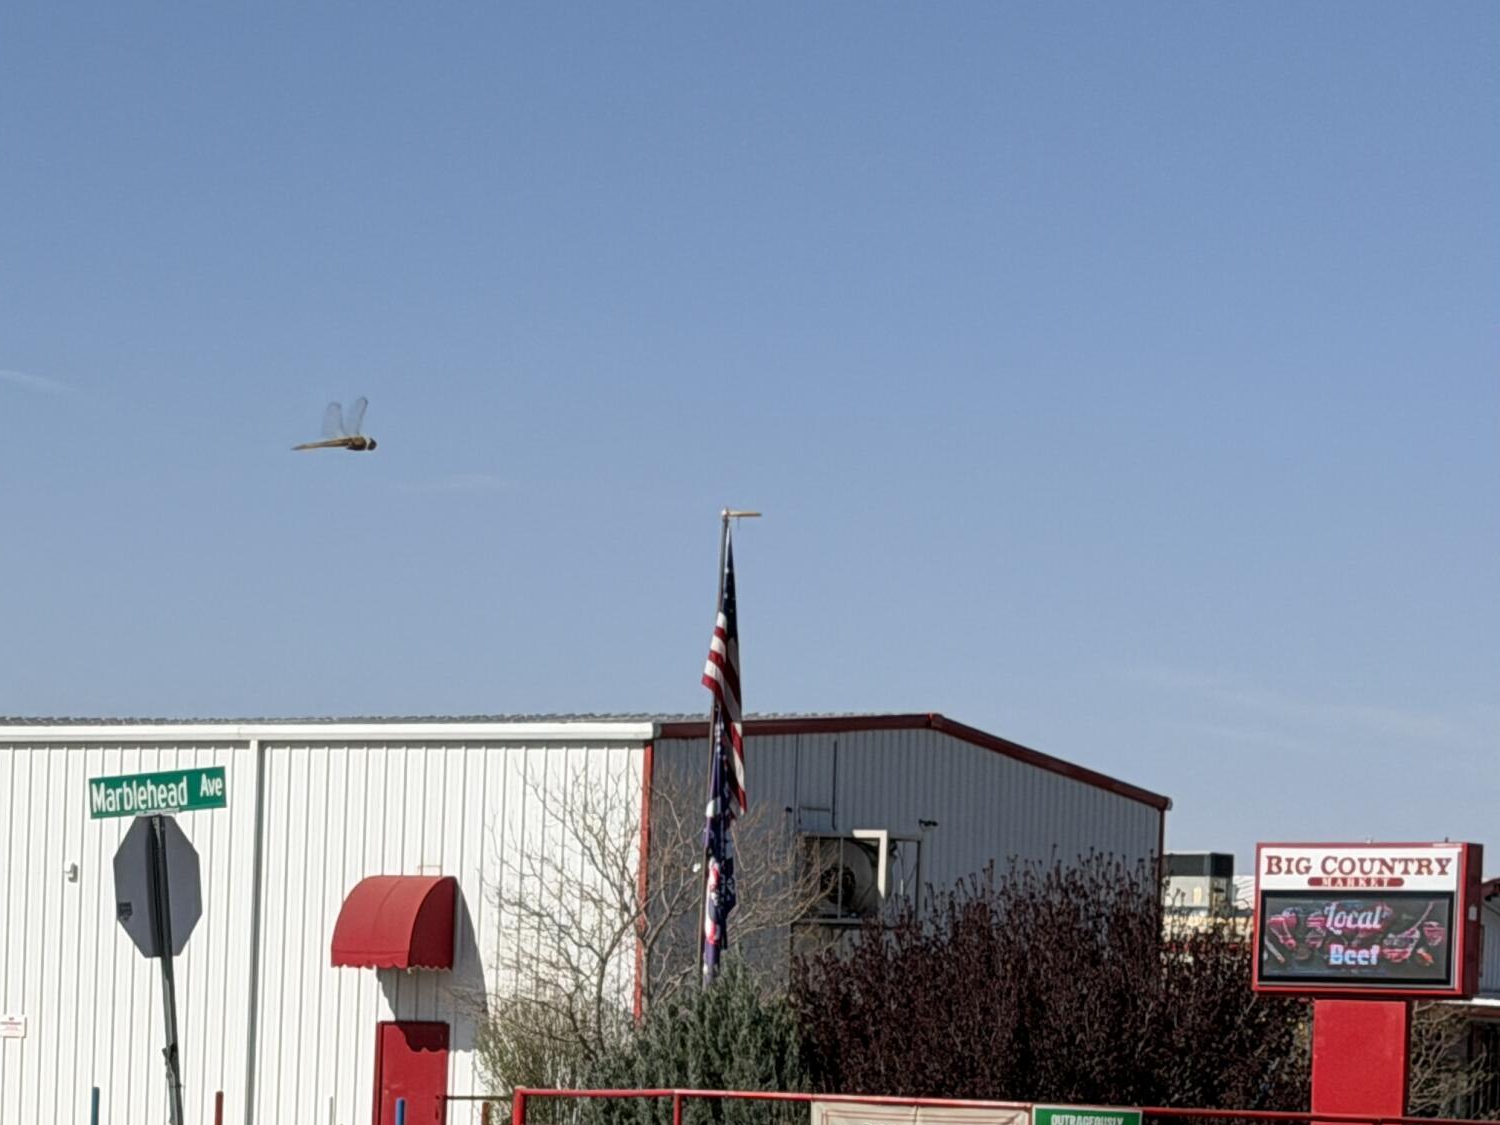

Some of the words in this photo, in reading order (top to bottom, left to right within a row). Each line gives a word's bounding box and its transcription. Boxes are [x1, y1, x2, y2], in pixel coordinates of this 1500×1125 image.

[91, 776, 188, 813] Marblehead
[200, 773, 223, 797] Ave
[1265, 855, 1312, 875] BIG
[1321, 855, 1452, 876] COUNTRY
[1322, 877, 1390, 887] MARKET
[1329, 943, 1381, 966] Beef
